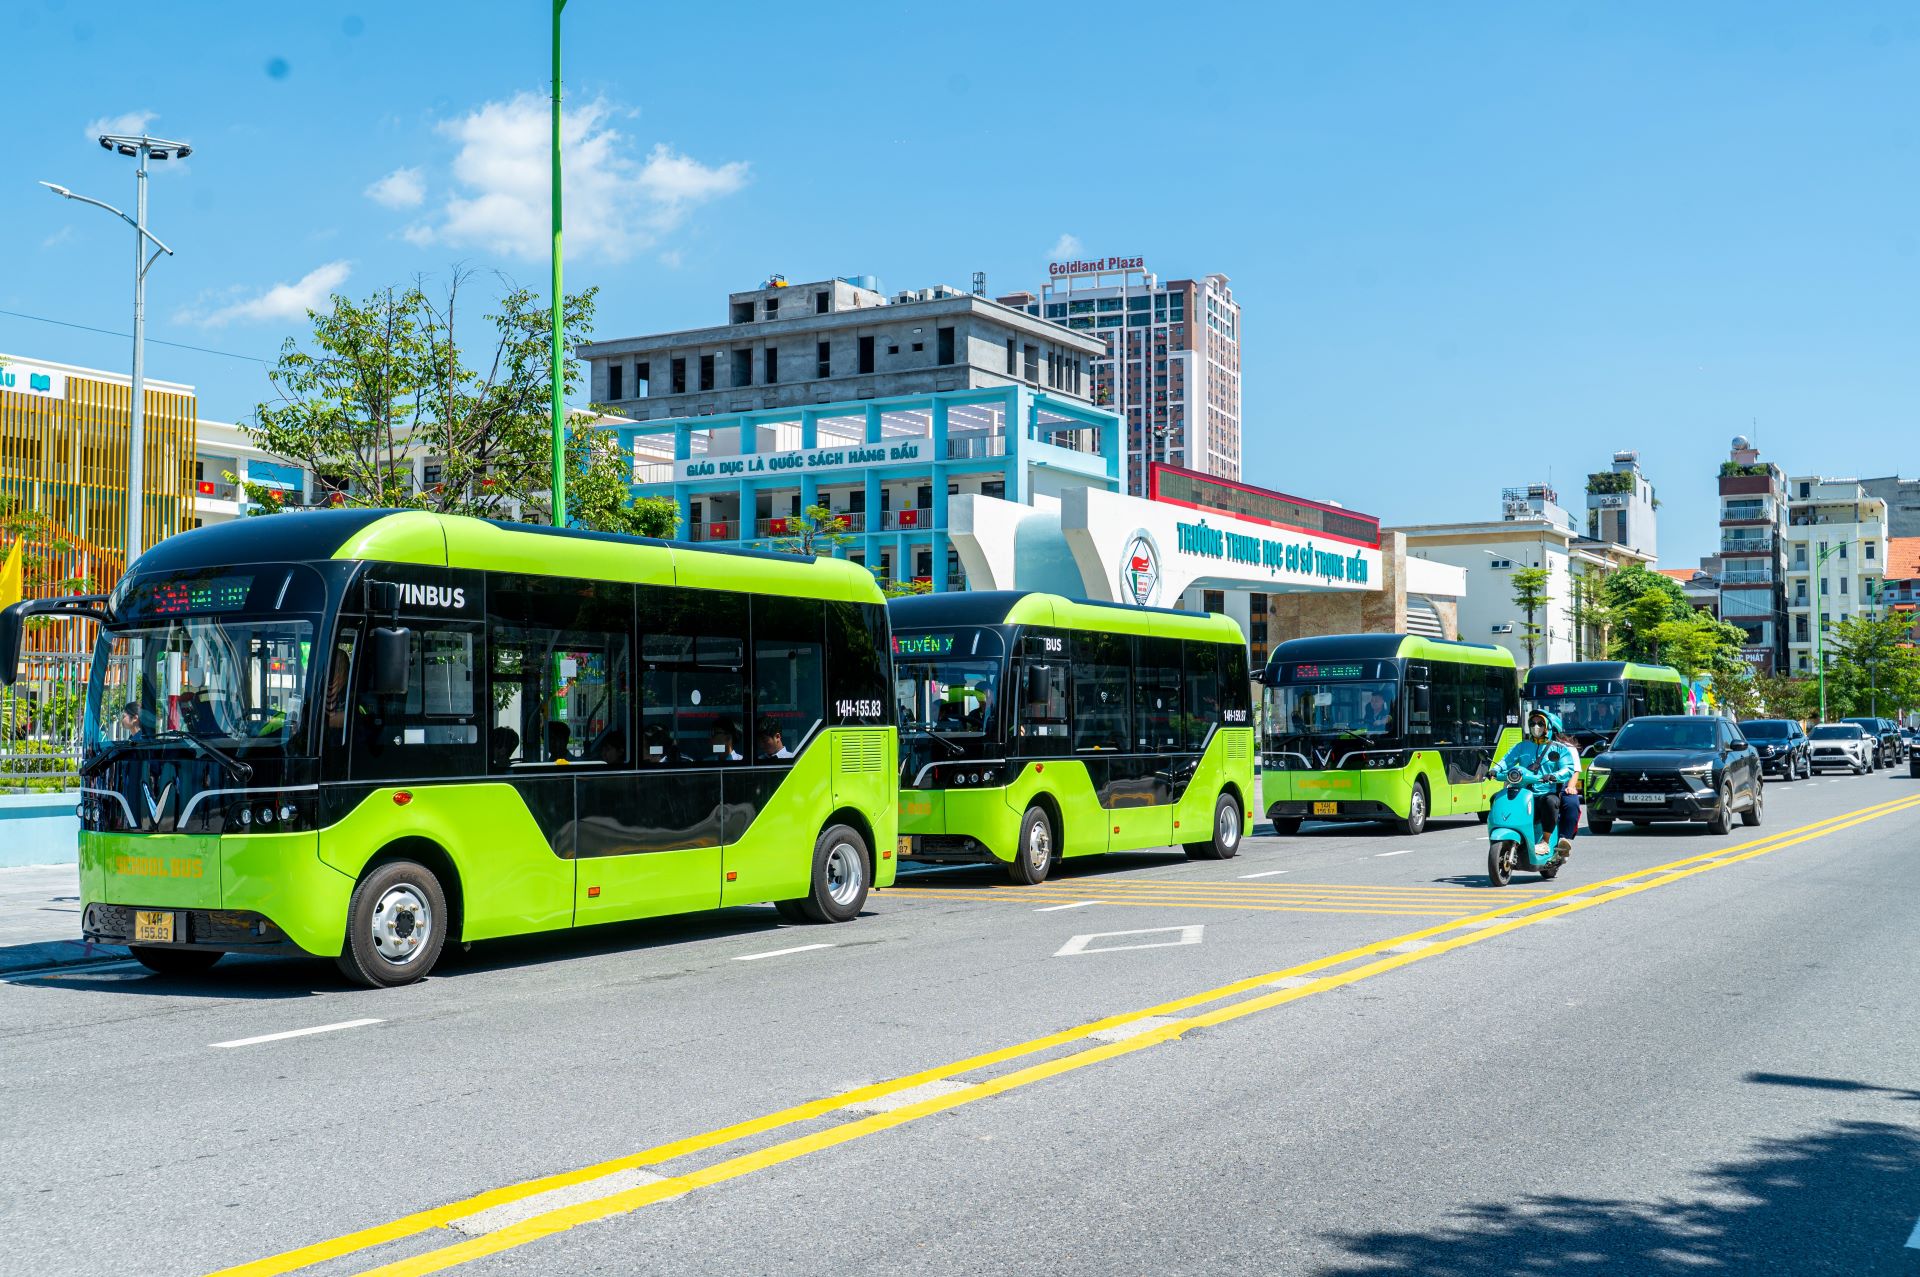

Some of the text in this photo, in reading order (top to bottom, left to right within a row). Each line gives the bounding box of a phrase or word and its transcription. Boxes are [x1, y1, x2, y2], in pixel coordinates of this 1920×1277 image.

[1049, 257, 1144, 275] Goldland Plaza
[686, 461, 715, 477] GIÁO
[719, 461, 744, 476] DỤC
[748, 456, 765, 472] LÀ
[769, 452, 804, 471] QUỐC
[808, 451, 844, 467] SÁCH
[848, 447, 886, 464] HÀNG
[1225, 531, 1261, 567] TRUNG
[1262, 539, 1284, 577] HỌC
[899, 634, 940, 653] TUYẾN
[835, 699, 881, 717] 14H-155.83
[115, 856, 204, 879] SCHOOL BUS
[147, 912, 163, 926] 14H
[140, 926, 169, 940] 155.83
